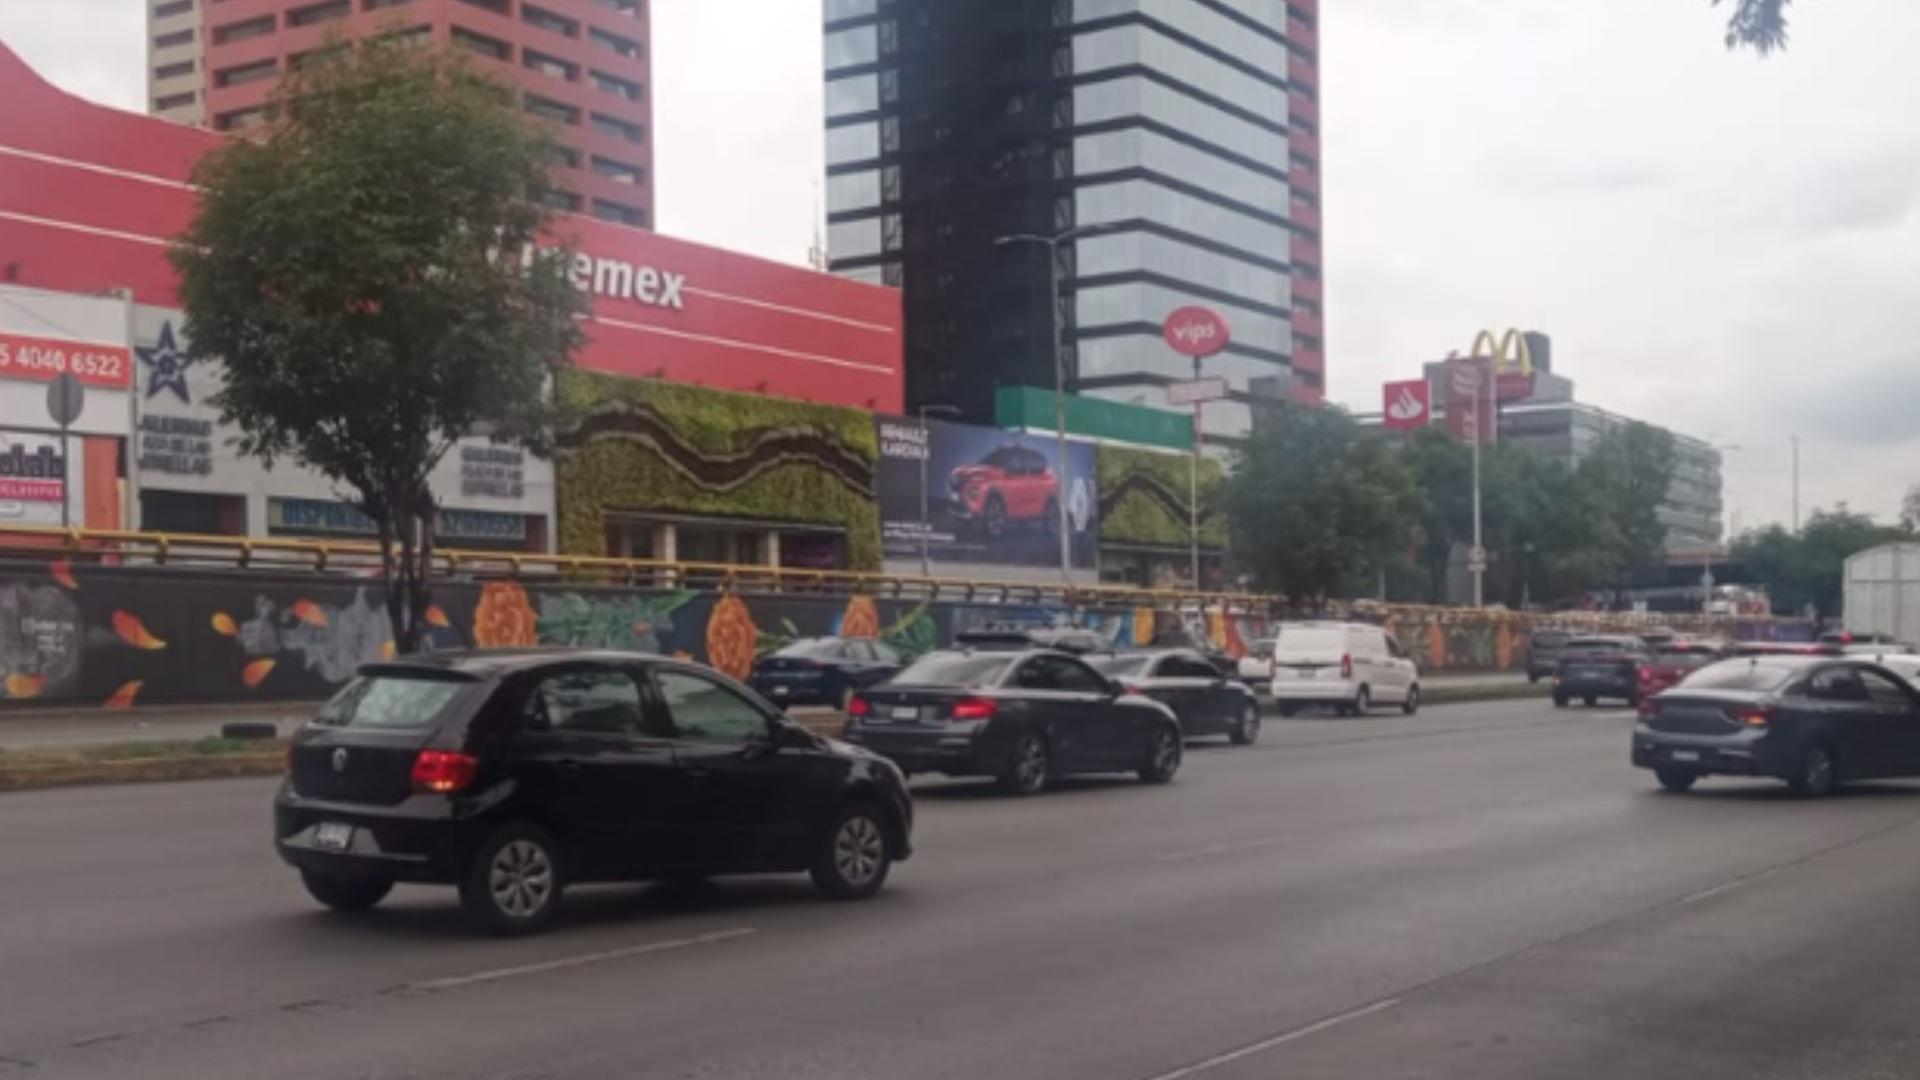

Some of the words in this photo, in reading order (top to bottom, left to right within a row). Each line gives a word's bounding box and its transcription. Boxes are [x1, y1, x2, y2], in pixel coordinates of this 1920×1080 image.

[1172, 320, 1216, 347] vips
[16, 345, 66, 373] 4040
[71, 352, 122, 377] 6522
